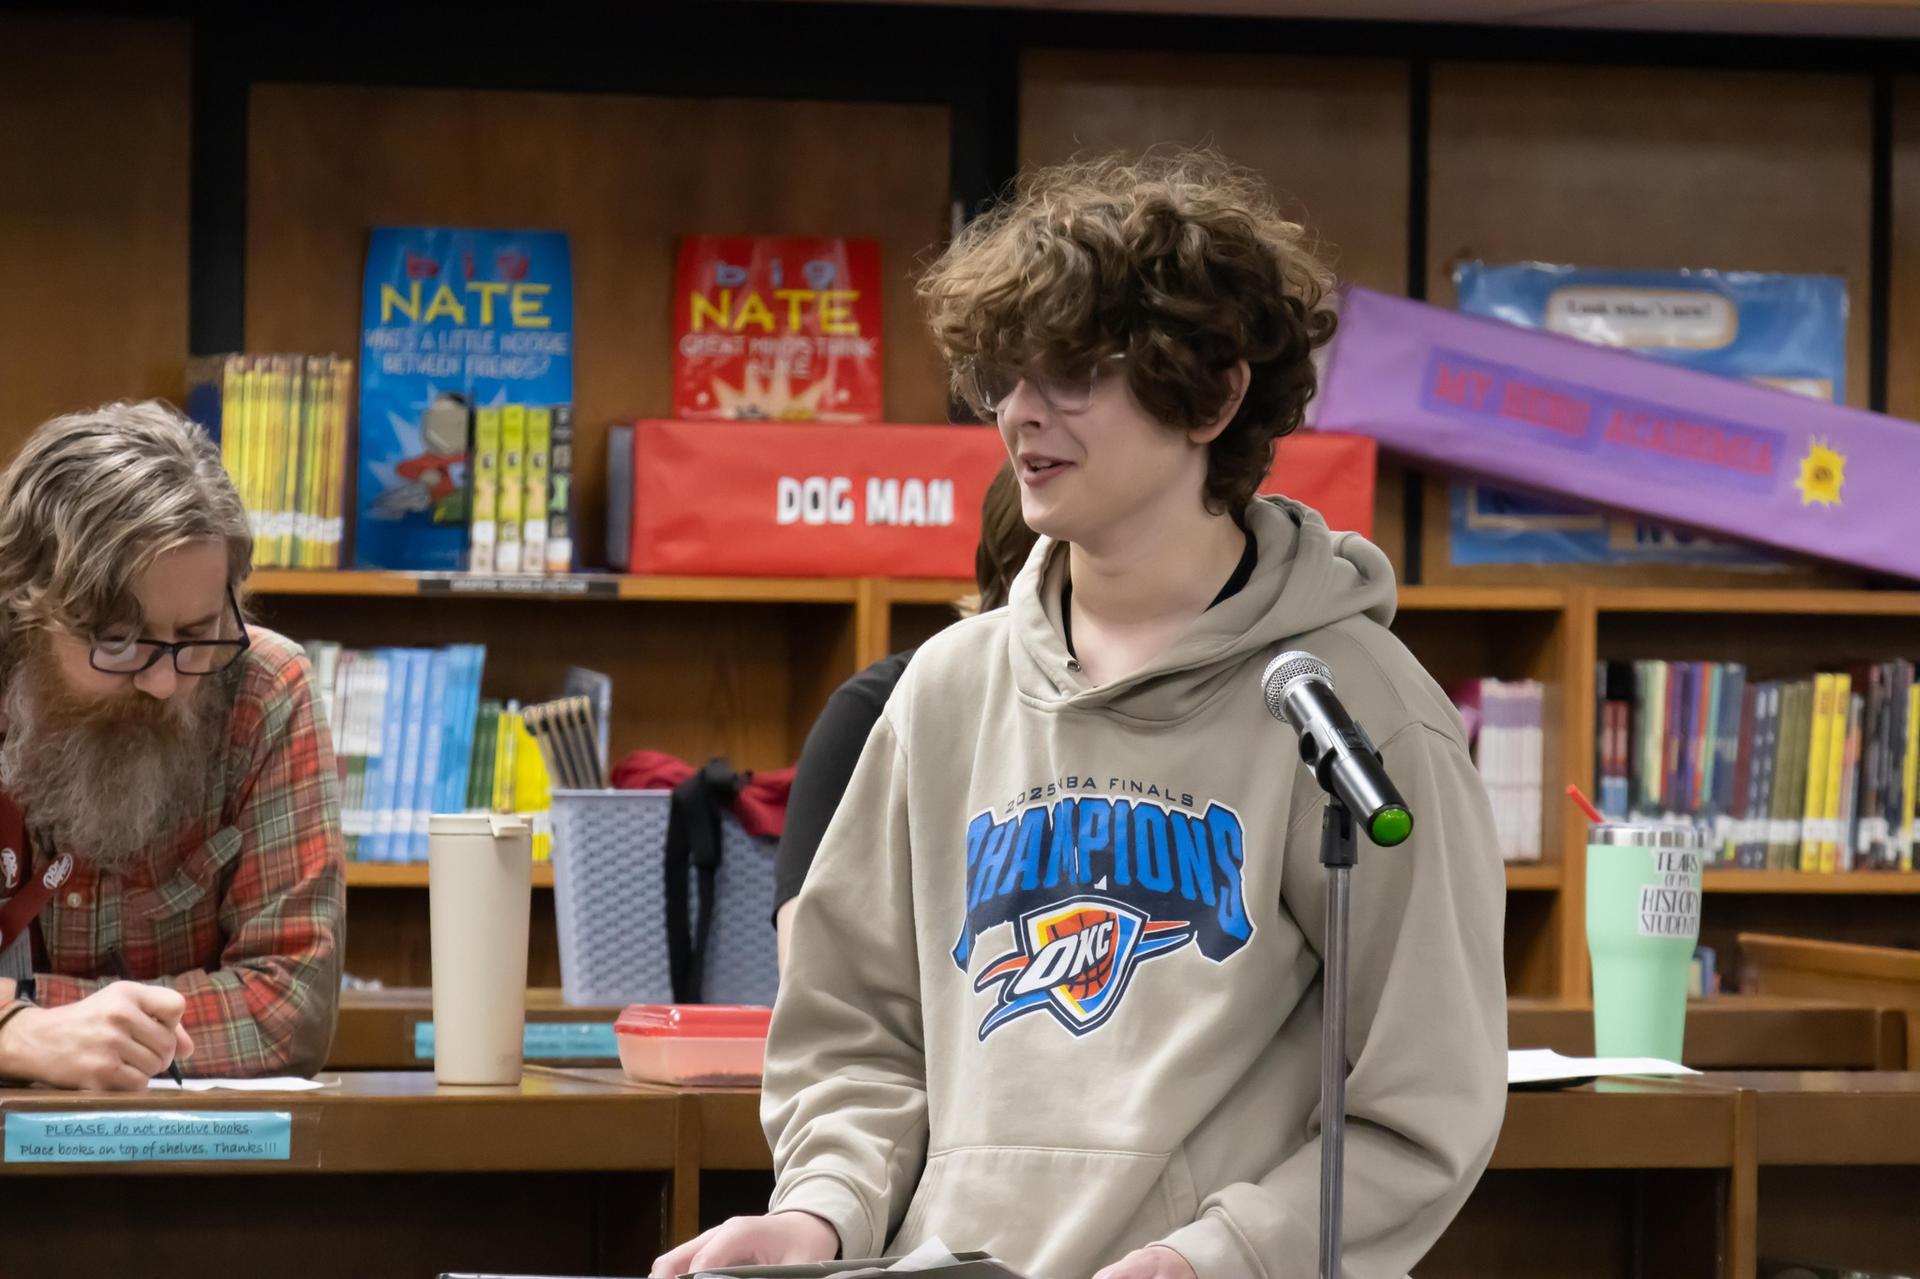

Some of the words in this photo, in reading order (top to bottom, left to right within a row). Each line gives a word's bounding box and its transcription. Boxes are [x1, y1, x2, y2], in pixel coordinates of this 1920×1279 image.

[381, 281, 551, 328] NATE
[691, 289, 860, 334] NATE
[1434, 365, 1493, 411] MY
[1499, 381, 1592, 438] HERO
[1603, 408, 1775, 477] ACADEMIA
[776, 475, 855, 526] DOG
[865, 476, 956, 527] MAN
[1005, 783, 1056, 814] 2025
[1109, 777, 1194, 808] FINALS
[1656, 850, 1698, 873] TEARS
[1013, 919, 1114, 995] OKC
[20, 1143, 54, 1156] Place
[58, 1143, 95, 1155] books
[99, 1146, 115, 1155] on
[119, 1143, 139, 1159] top
[142, 1141, 157, 1158] of
[212, 1142, 277, 1154] Thanks!!!
[45, 1123, 109, 1137] PLEASE,
[114, 1123, 129, 1136] do
[133, 1123, 154, 1136] not
[158, 1121, 209, 1136] reshelve
